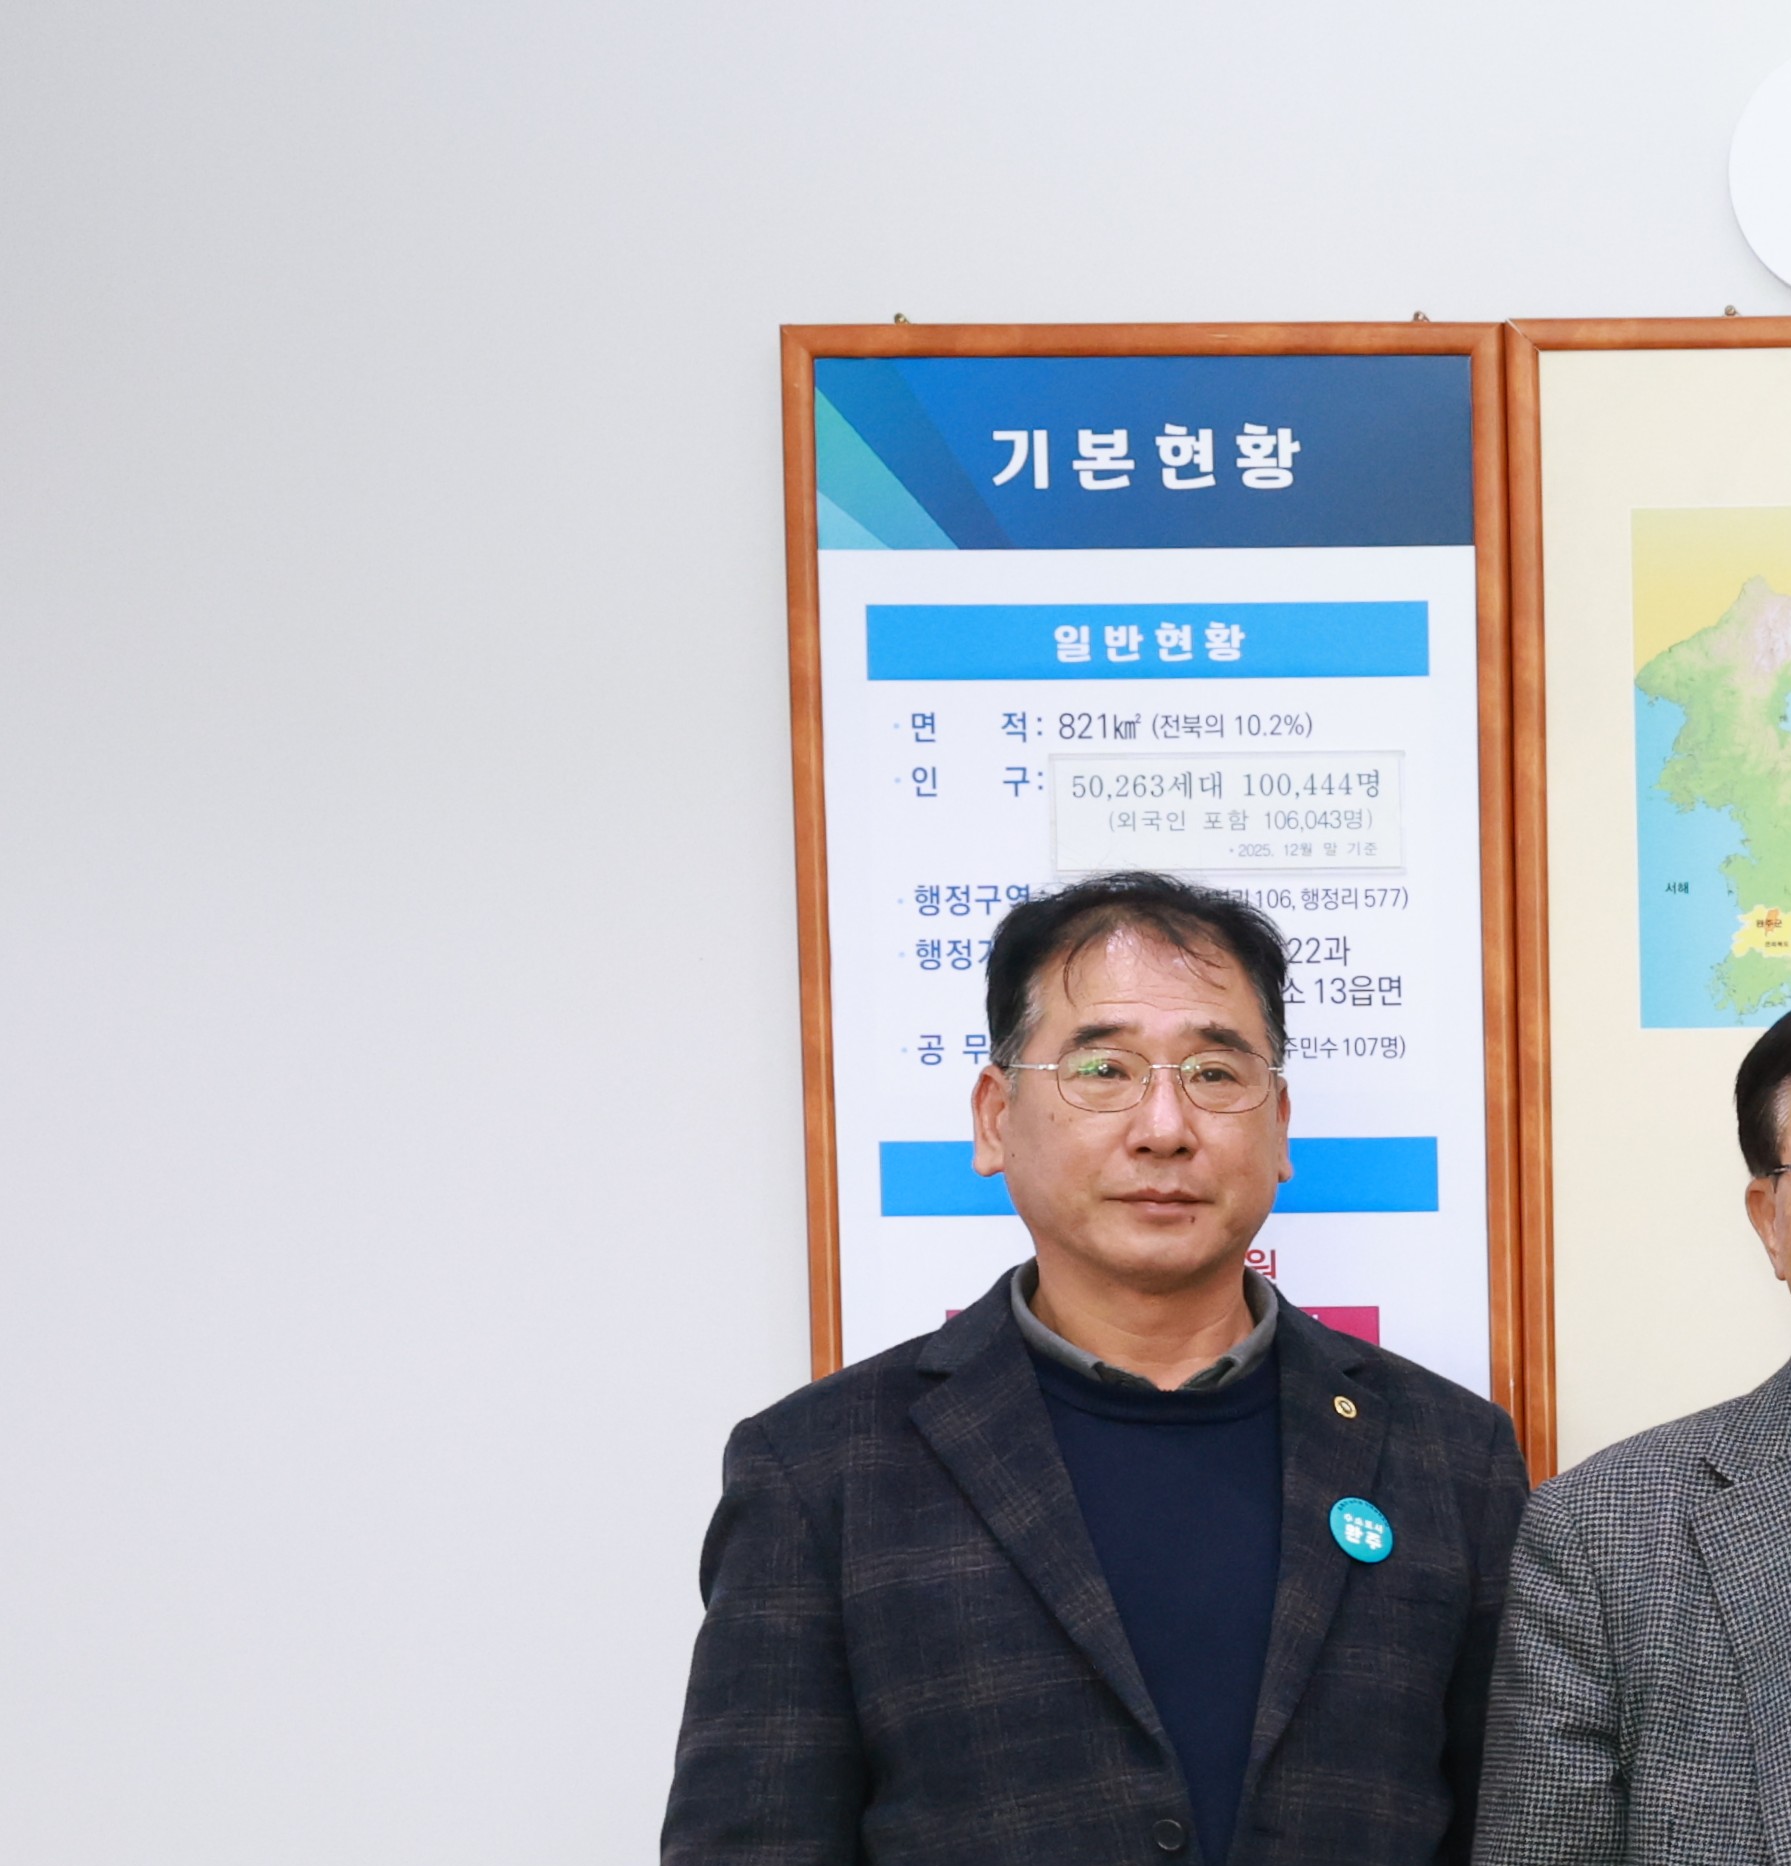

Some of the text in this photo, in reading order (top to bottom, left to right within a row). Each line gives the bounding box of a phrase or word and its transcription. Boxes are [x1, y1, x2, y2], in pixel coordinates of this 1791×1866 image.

[991, 423, 1301, 491] 기본현황
[1053, 622, 1246, 663] 일반현황
[1151, 712, 1226, 741] (전북의
[1234, 712, 1314, 740] 10.2%)
[1070, 768, 1382, 801] 50,263세대 100,444명
[1107, 807, 1374, 834] (외국인 포함 106,043명)
[1284, 841, 1313, 858] 12월
[1323, 841, 1337, 857] 말
[1346, 841, 1378, 857] 기준
[1665, 882, 1690, 895] 서해
[1314, 975, 1402, 1006] 13읍면
